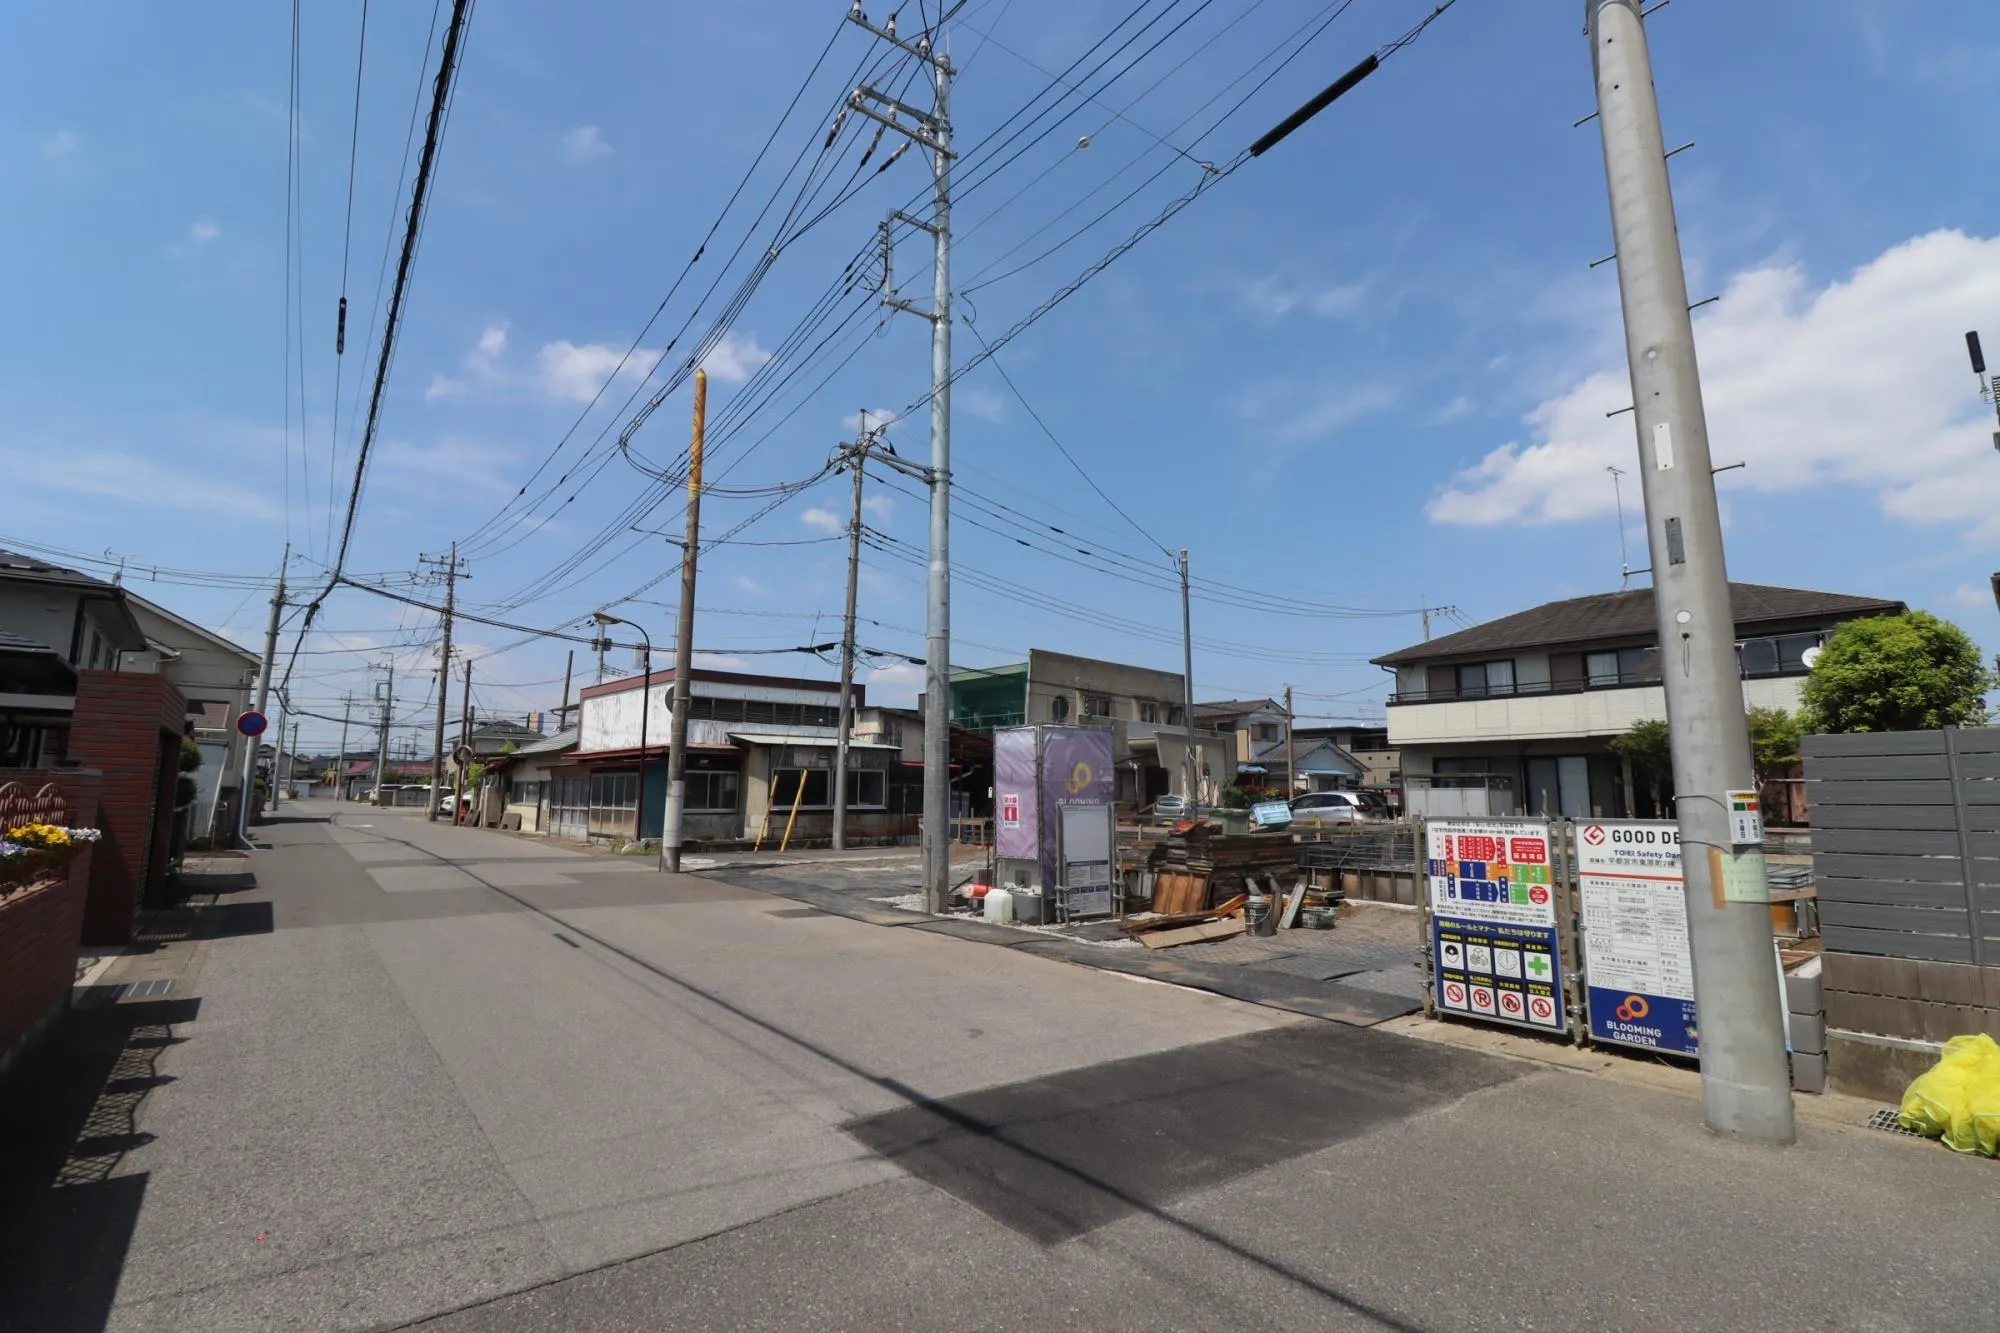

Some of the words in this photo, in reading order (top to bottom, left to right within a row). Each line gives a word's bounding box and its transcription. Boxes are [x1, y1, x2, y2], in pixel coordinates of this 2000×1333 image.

[1612, 829, 1656, 844] GOOD
[1636, 850, 1663, 859] Safety
[1606, 1020, 1662, 1038] BLOOMING
[1613, 1030, 1656, 1047] GARDEN
